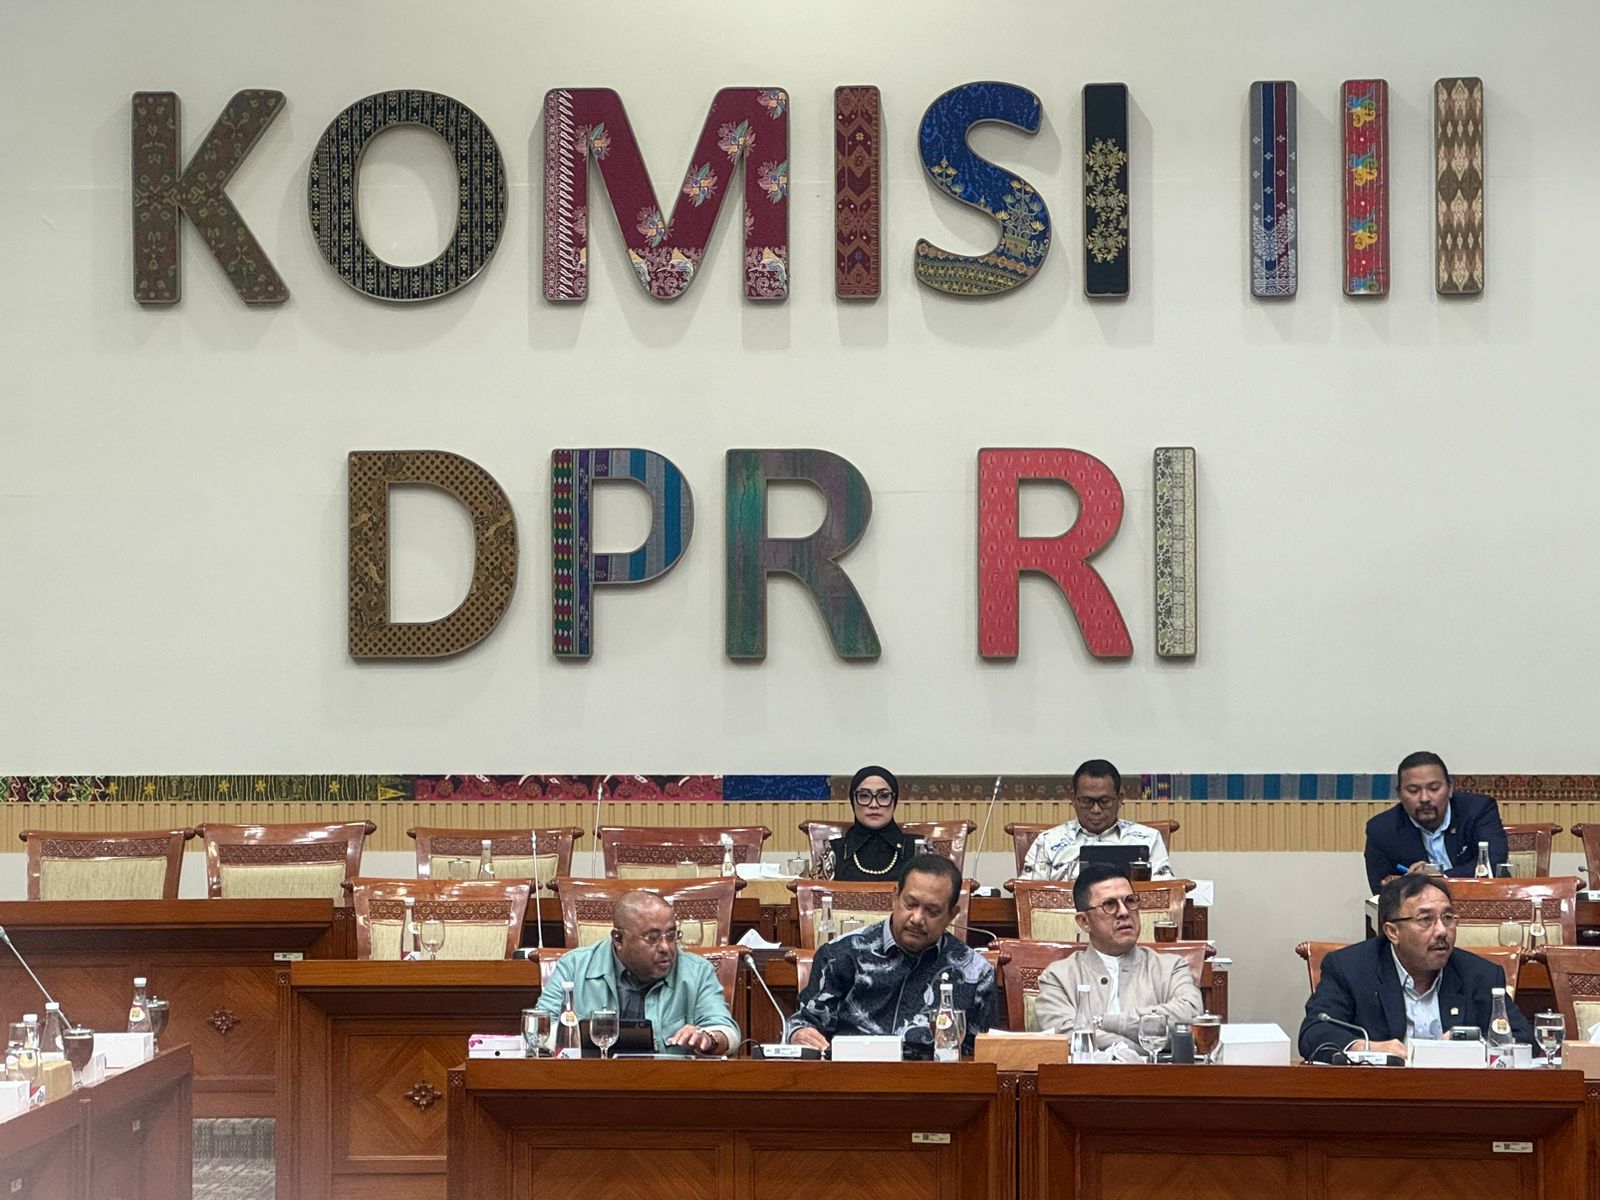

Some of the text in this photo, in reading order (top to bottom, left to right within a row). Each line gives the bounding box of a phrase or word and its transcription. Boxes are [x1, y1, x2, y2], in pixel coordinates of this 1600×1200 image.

[131, 77, 1485, 305] KOMISI III
[348, 447, 1197, 664] DPR RI
